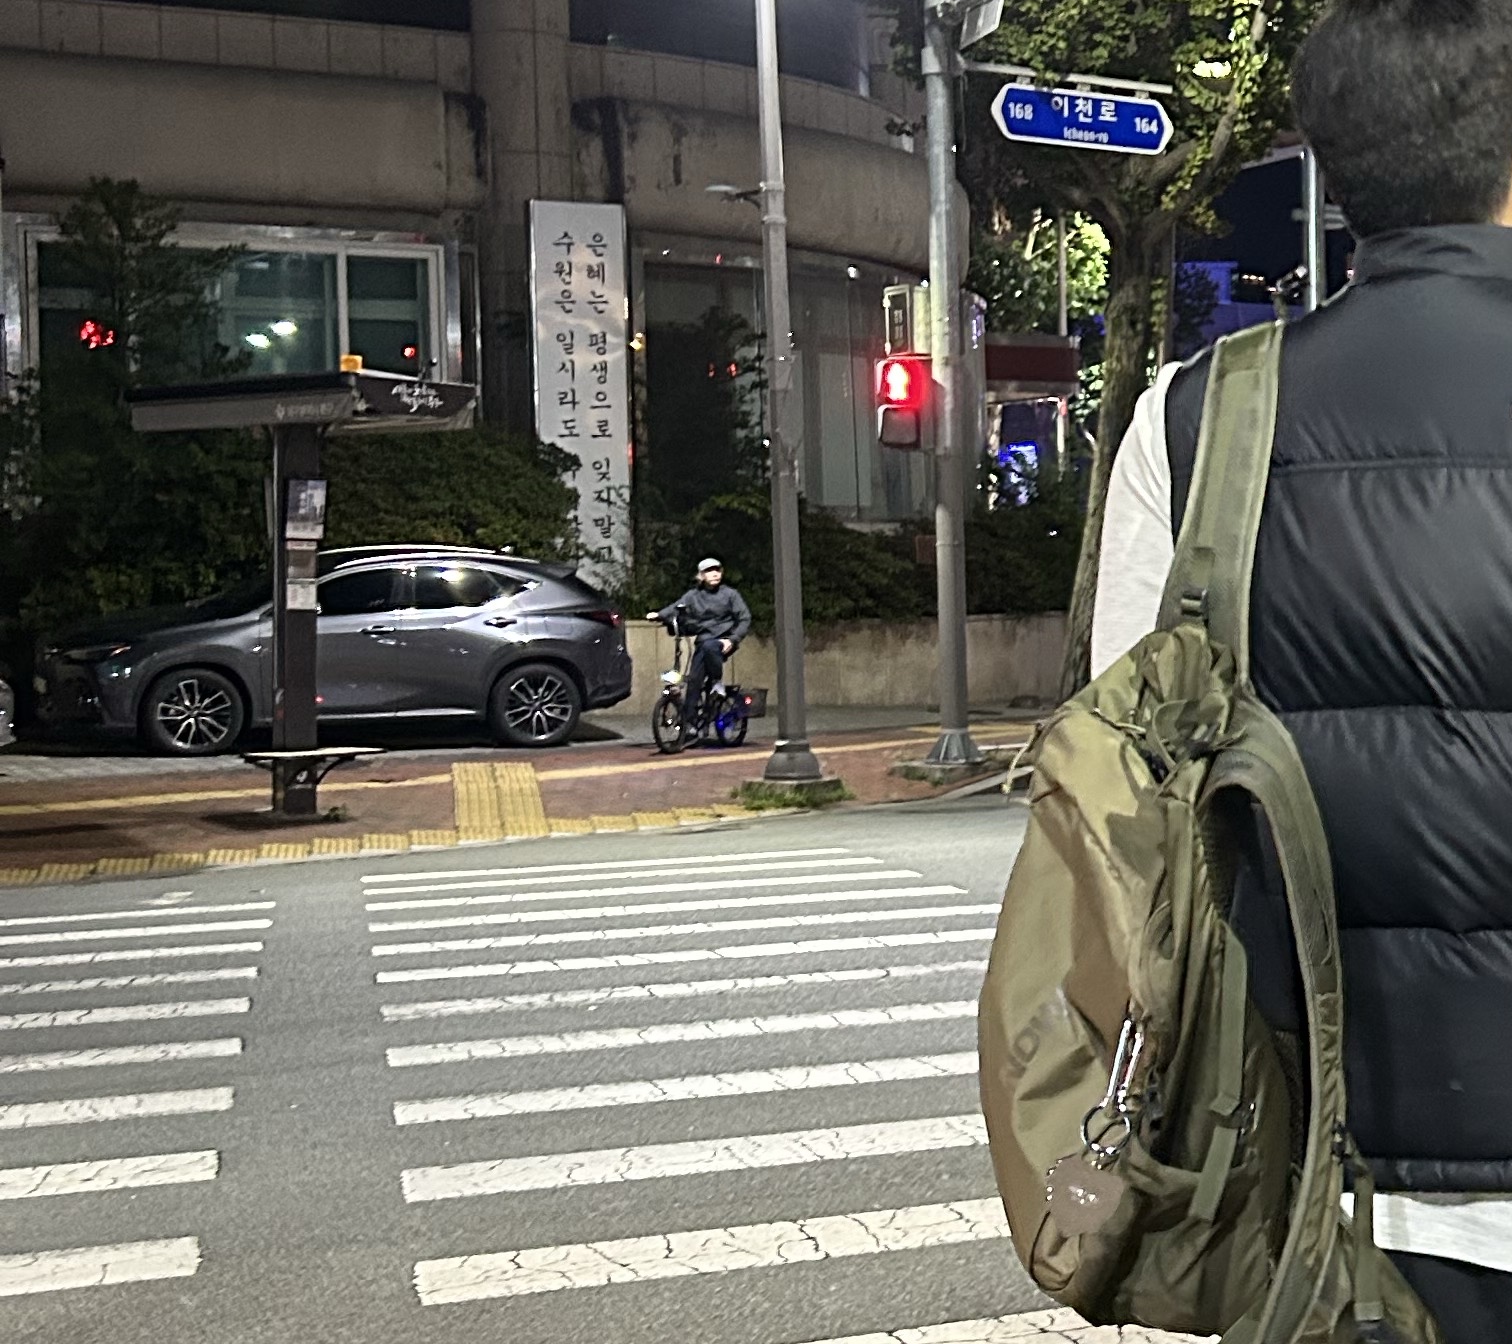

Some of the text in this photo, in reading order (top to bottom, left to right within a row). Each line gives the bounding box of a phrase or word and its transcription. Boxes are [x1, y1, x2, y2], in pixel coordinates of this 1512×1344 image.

[1008, 102, 1034, 121] 168
[1051, 96, 1118, 123] 이천로
[1134, 117, 1159, 135] 164
[553, 231, 576, 314] 수원은
[586, 232, 610, 314] 은혜는
[556, 330, 580, 439] 일시라도
[587, 331, 612, 439] 평생으로
